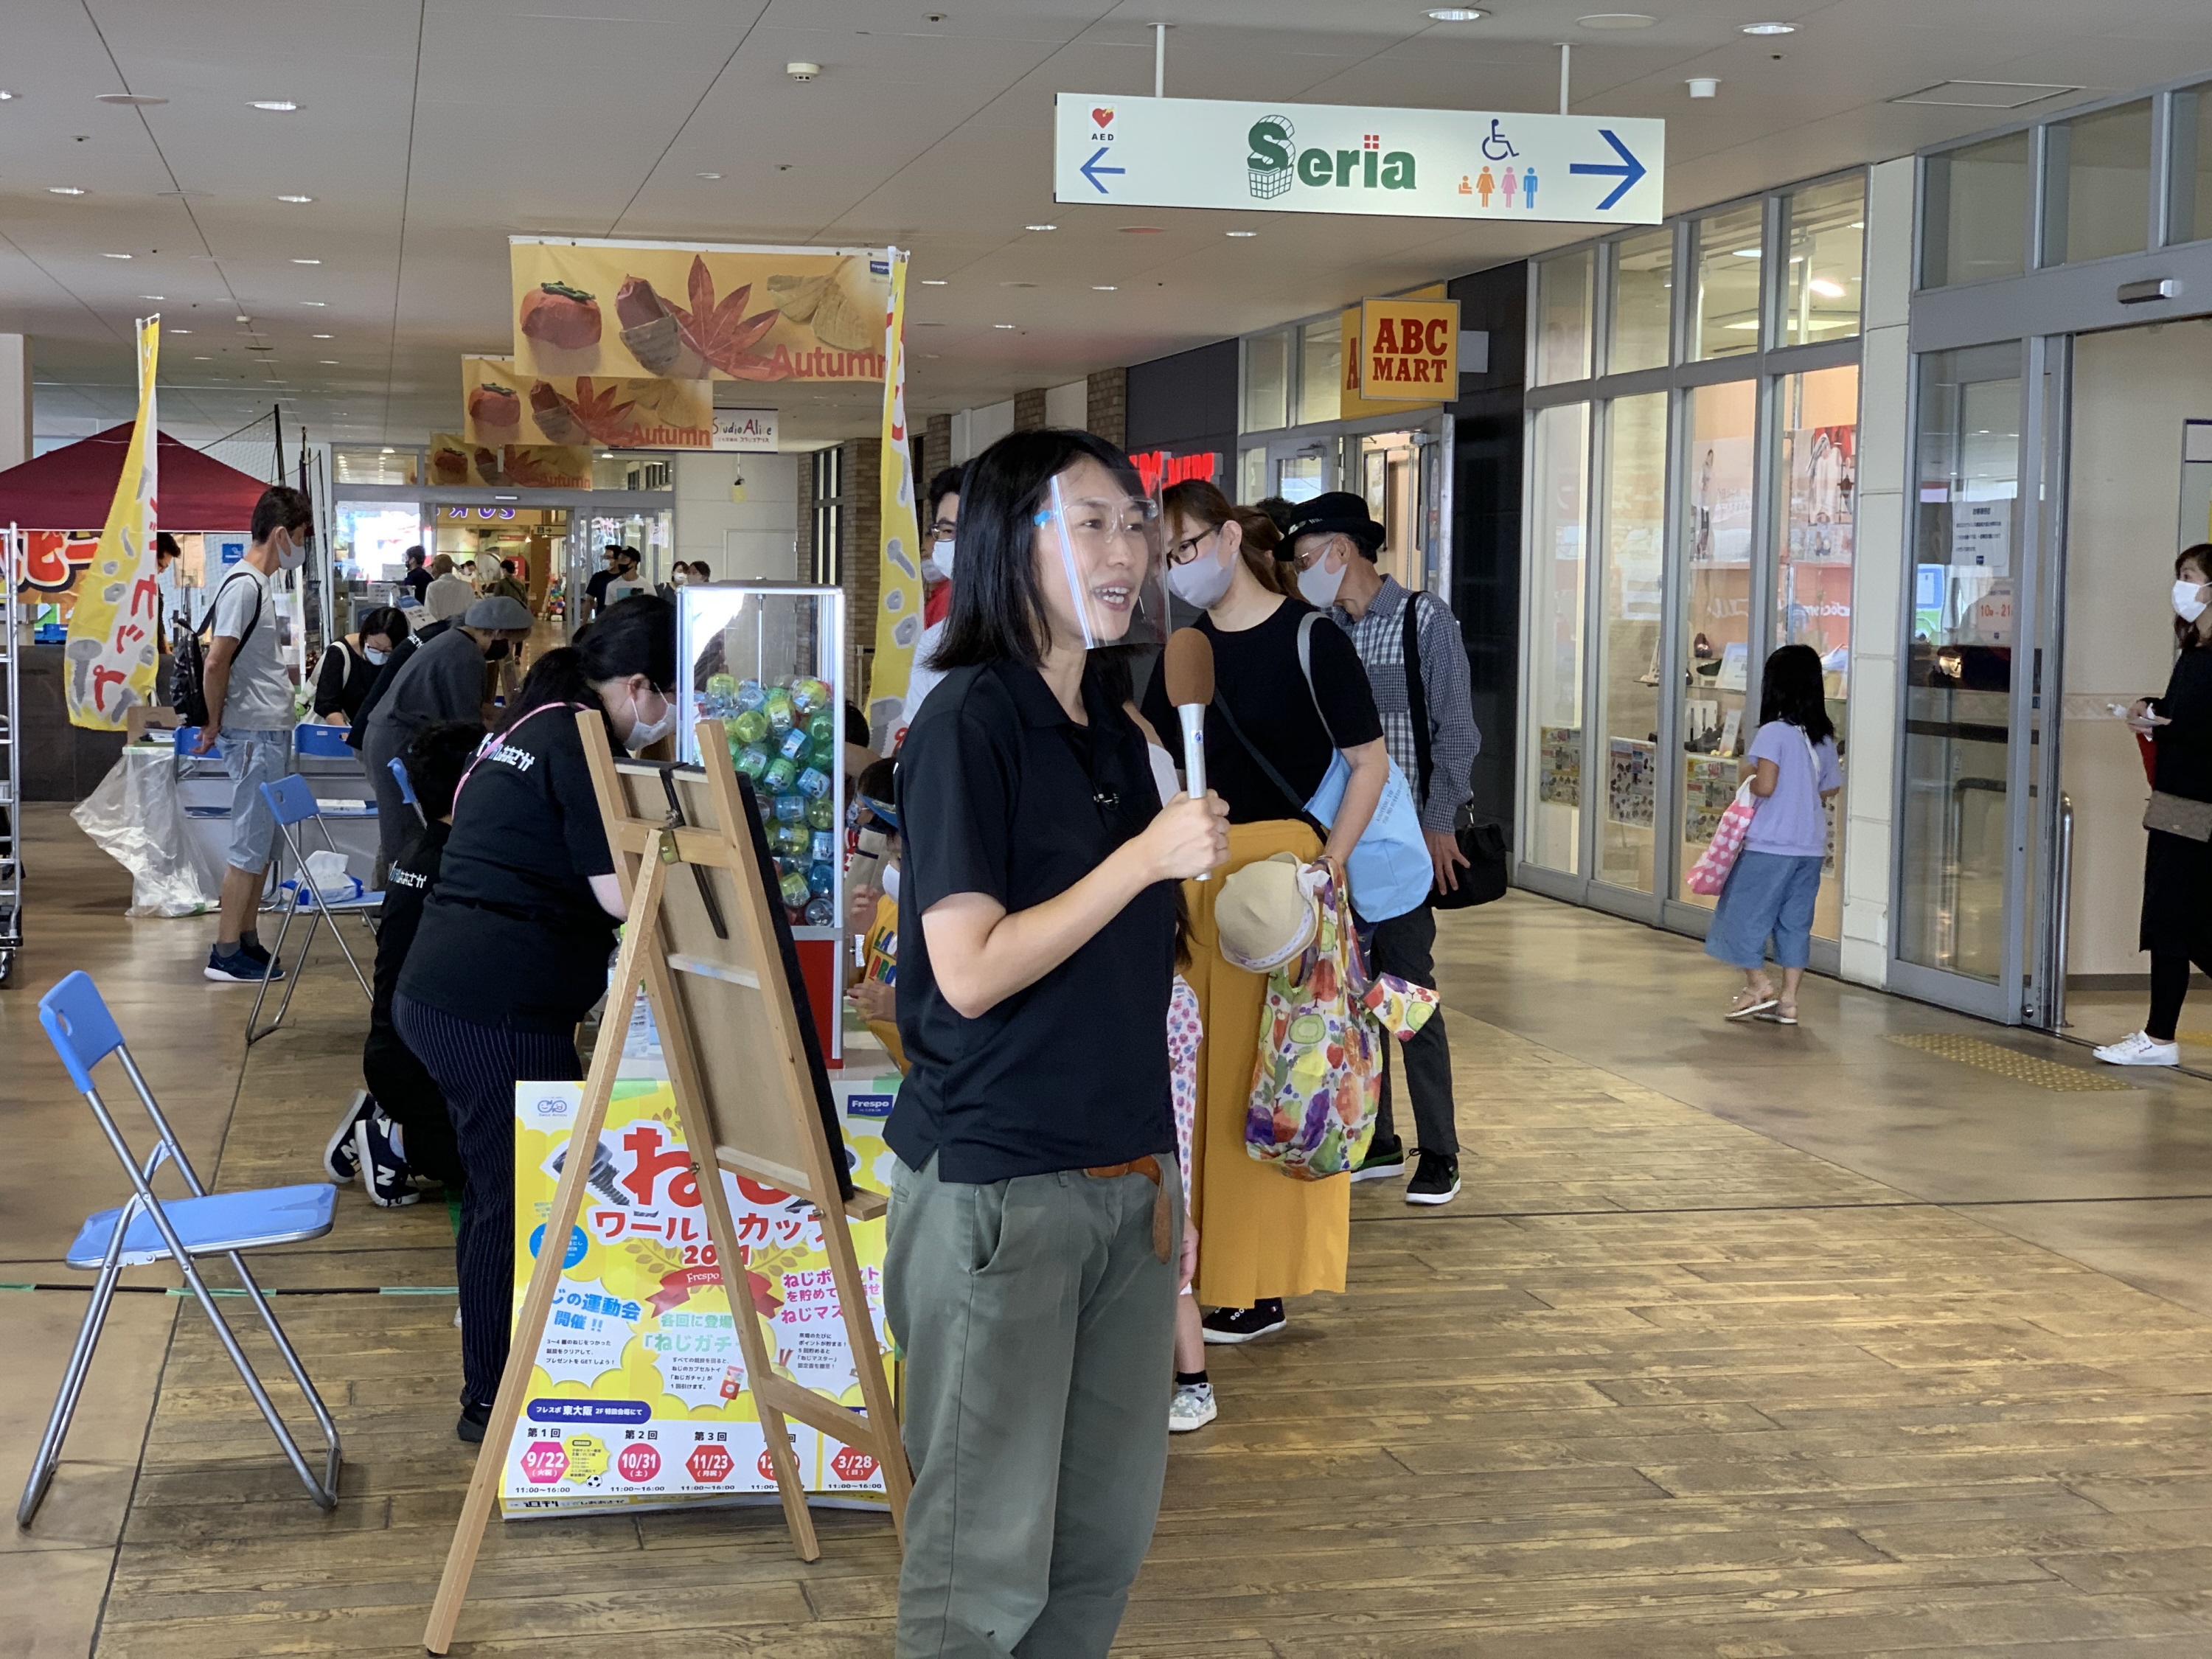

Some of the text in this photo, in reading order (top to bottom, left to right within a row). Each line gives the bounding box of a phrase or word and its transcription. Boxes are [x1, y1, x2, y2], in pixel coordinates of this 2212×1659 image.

[1091, 133, 1114, 141] AED
[1248, 115, 1417, 190] Seria
[1373, 318, 1448, 356] ABC
[1373, 357, 1447, 383] MART
[713, 417, 742, 434] Studio
[631, 423, 711, 445] Autumn
[2001, 604, 2012, 616] 21
[852, 1100, 889, 1108] Frespo
[595, 1212, 824, 1242] ワールカッ
[684, 1245, 749, 1265] 201
[686, 1273, 720, 1282] Frespo
[784, 1267, 879, 1288] ねじポト
[787, 1284, 880, 1301] を貯めてせ
[552, 1289, 641, 1321] じの運動会
[661, 1314, 733, 1329] 各回に登場
[782, 1305, 877, 1324] ねじマスー
[645, 1334, 740, 1353] 「ねじガチ
[527, 1428, 561, 1438] 第1回
[625, 1430, 658, 1440] 第2回
[695, 1431, 727, 1441] 第3回
[526, 1452, 565, 1468] 9/22
[622, 1453, 656, 1469] 10/31
[693, 1454, 728, 1469] 11/23
[838, 1455, 872, 1468] 3/28
